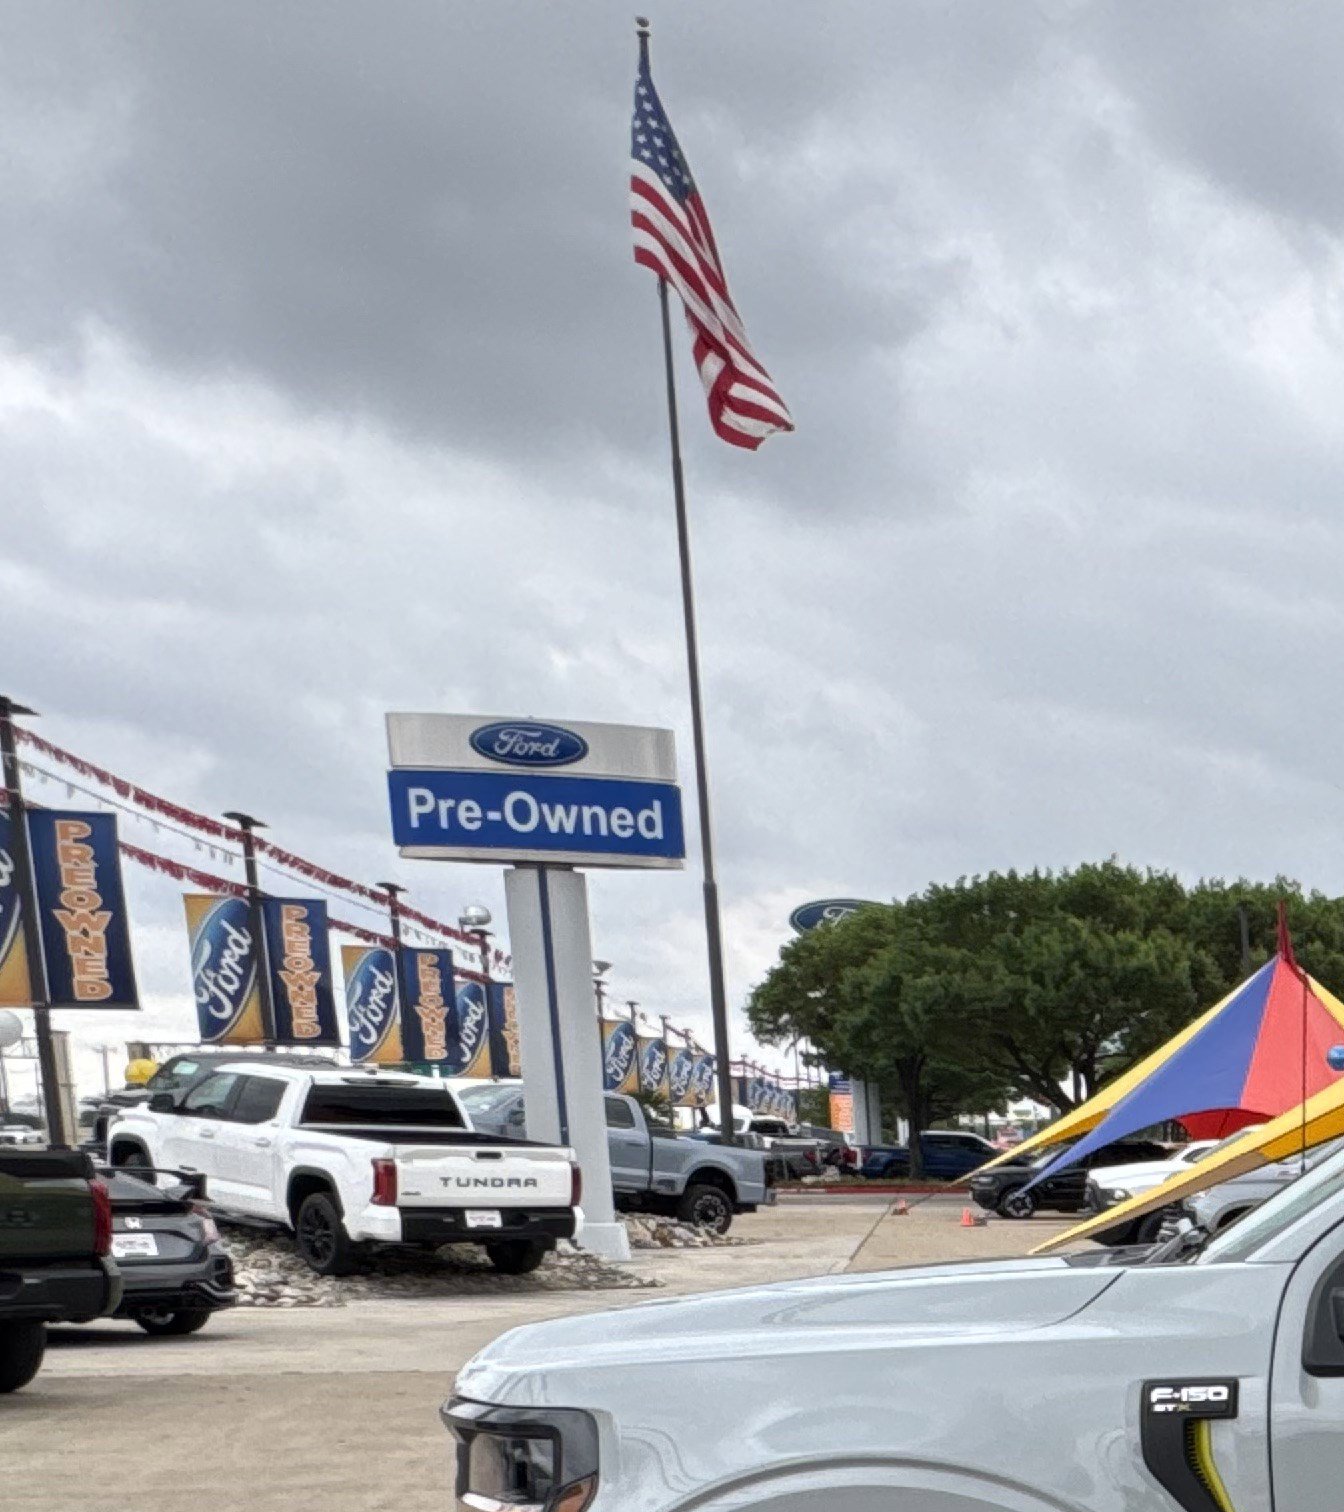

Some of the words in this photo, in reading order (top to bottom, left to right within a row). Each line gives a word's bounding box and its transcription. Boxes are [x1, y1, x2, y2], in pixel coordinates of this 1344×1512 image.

[494, 727, 561, 758] Ford
[406, 786, 664, 840] Pre-Owned
[52, 819, 114, 1001] PREOWNED
[194, 918, 252, 1020] Ford
[276, 904, 322, 1039] PREOWNED
[349, 965, 394, 1045] Ford
[439, 1176, 538, 1188] TUNDRA
[1150, 1386, 1229, 1403] F-150
